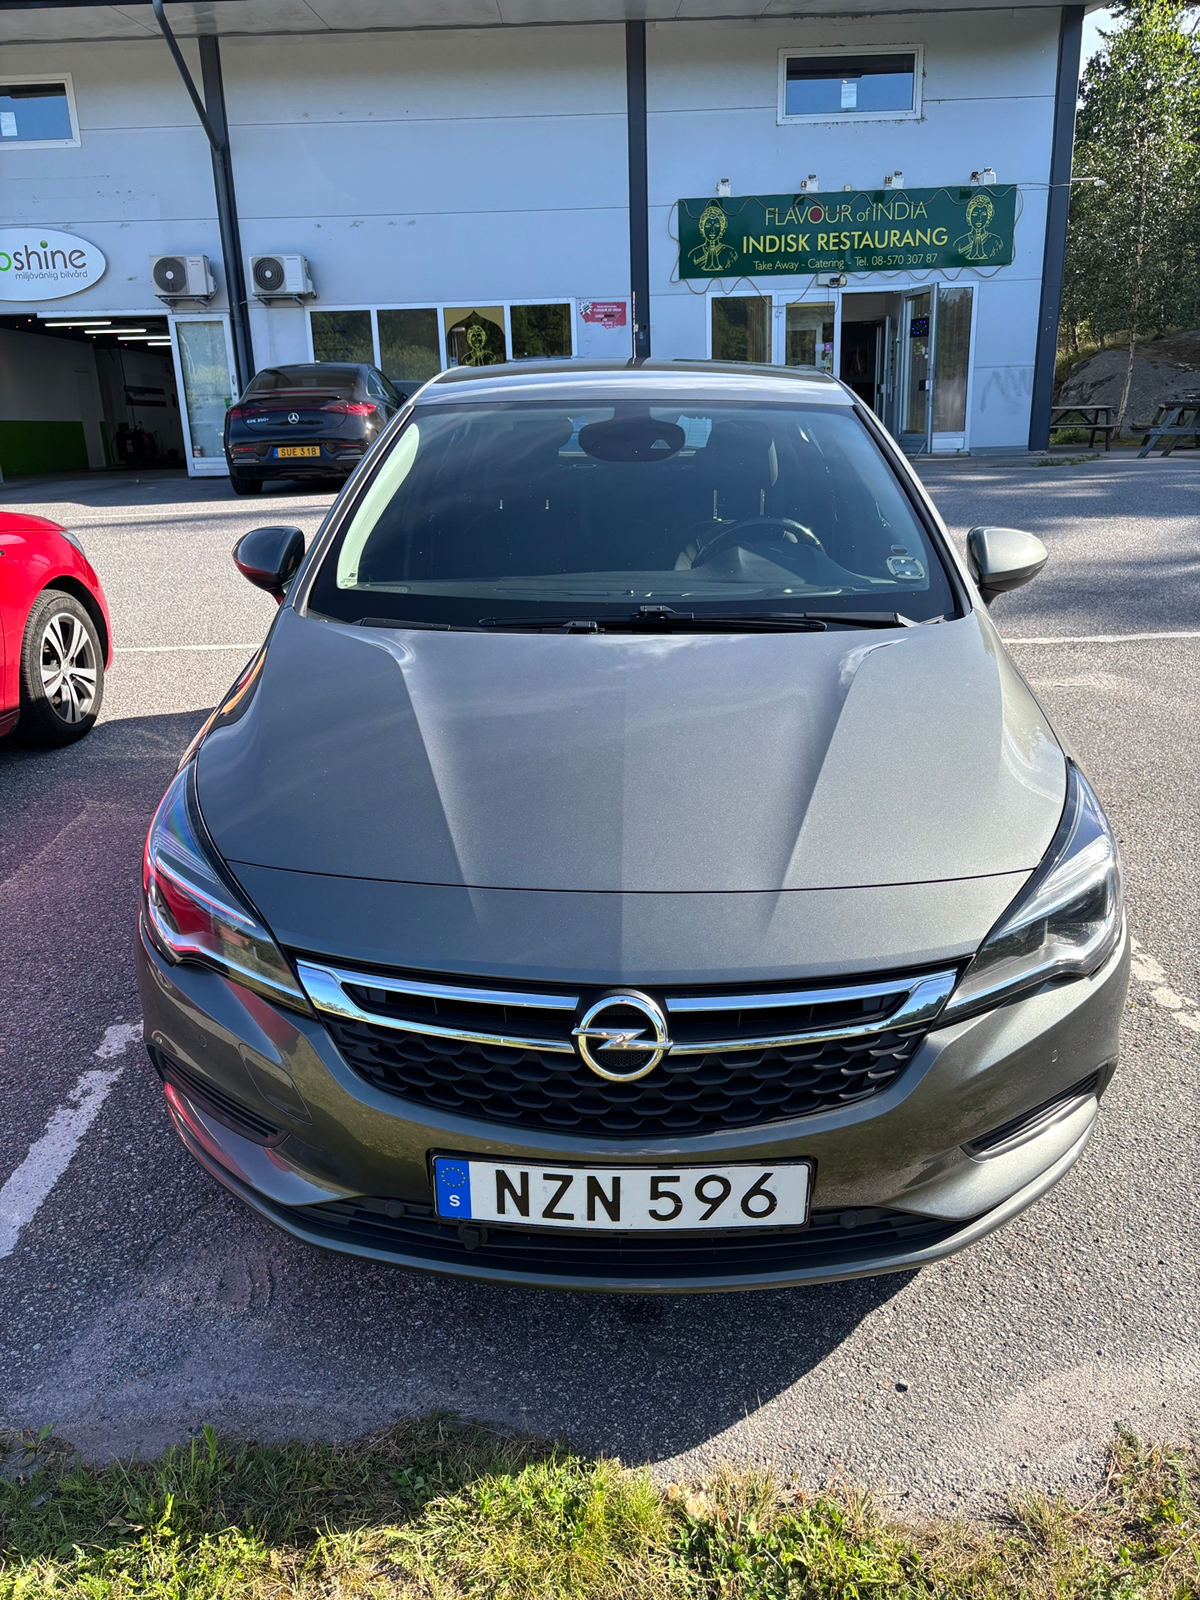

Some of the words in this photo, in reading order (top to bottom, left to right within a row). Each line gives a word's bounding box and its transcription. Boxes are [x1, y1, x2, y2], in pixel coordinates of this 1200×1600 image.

[764, 204, 853, 226] FLAVOUR
[856, 207, 871, 222] of
[872, 201, 928, 221] INDIA
[743, 233, 811, 254] INDISK
[817, 228, 948, 251] RESTAURANG
[753, 260, 773, 271] Take
[774, 259, 799, 271] Away
[807, 257, 845, 270] Catering
[855, 256, 869, 266] Tel.
[871, 255, 905, 266] 08-570
[906, 254, 924, 264] 307
[925, 253, 938, 263] 87
[15, 271, 59, 281] miljövänlig
[60, 270, 88, 279] bilvård
[281, 448, 297, 457] SUE
[299, 447, 317, 456] 31B
[449, 1194, 461, 1207] S
[495, 1169, 621, 1222] NZN
[648, 1172, 778, 1222] 596
